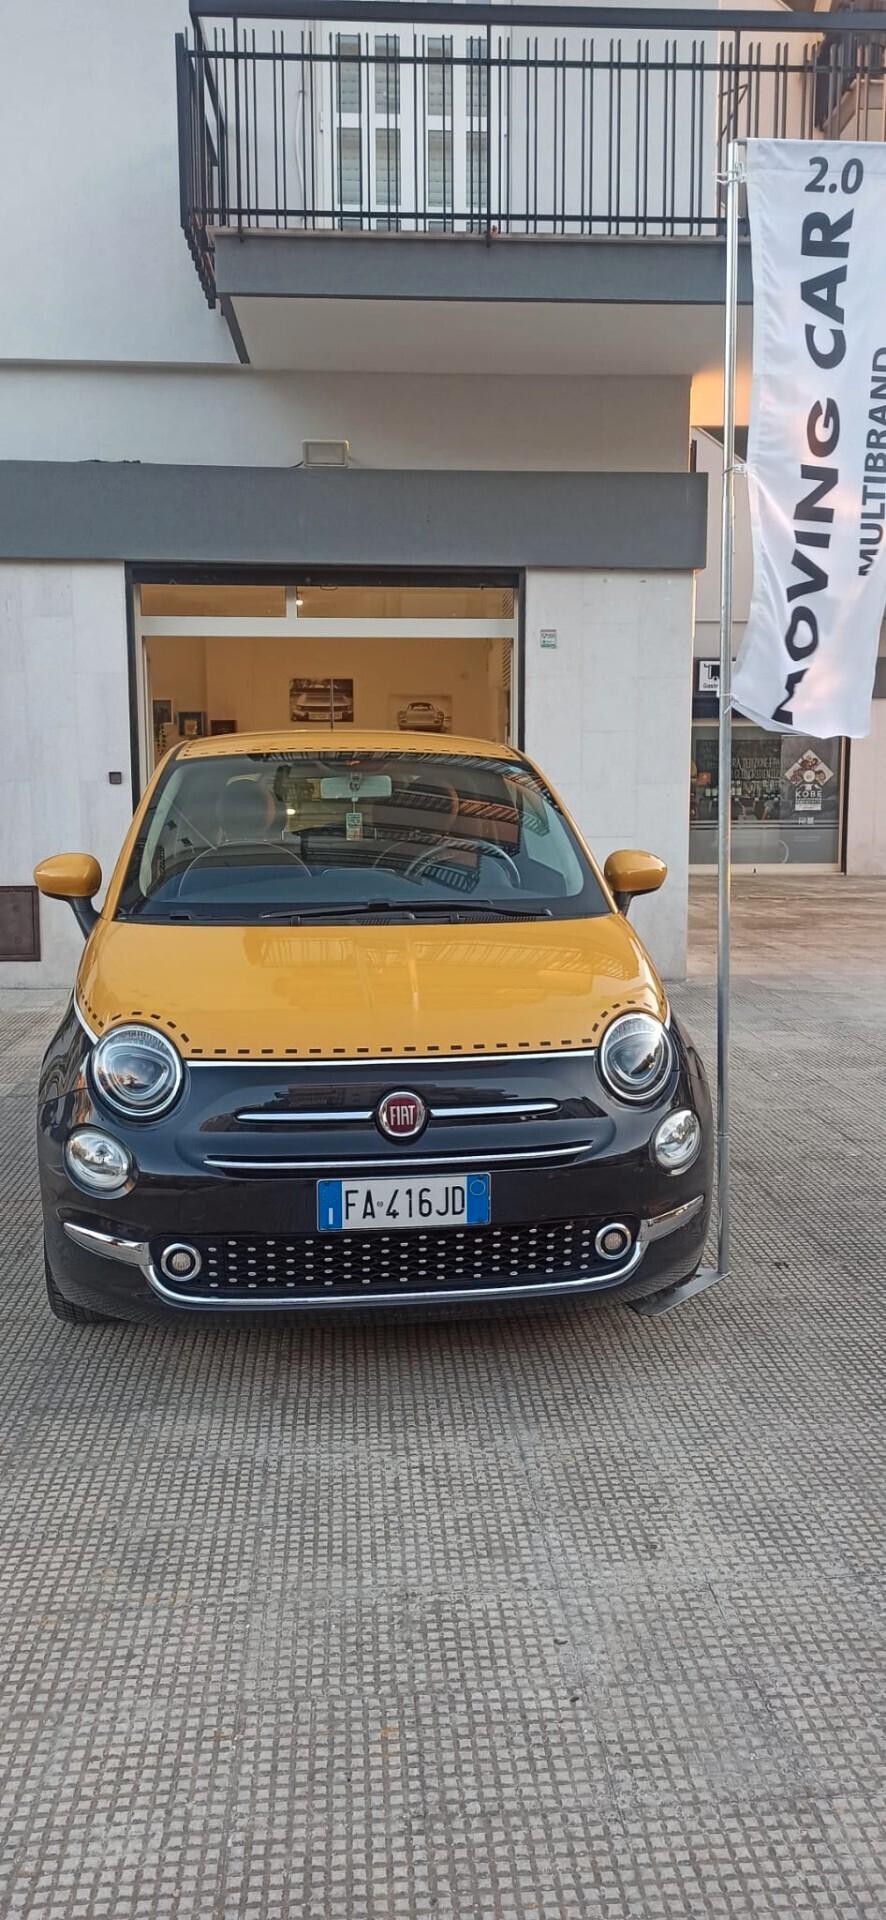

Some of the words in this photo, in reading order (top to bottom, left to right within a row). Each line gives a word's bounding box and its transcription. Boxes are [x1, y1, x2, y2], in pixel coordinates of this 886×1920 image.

[804, 156, 864, 194] 2.0
[800, 208, 854, 369] CAR
[795, 790, 823, 798] KOBE
[390, 1104, 416, 1126] FIAT
